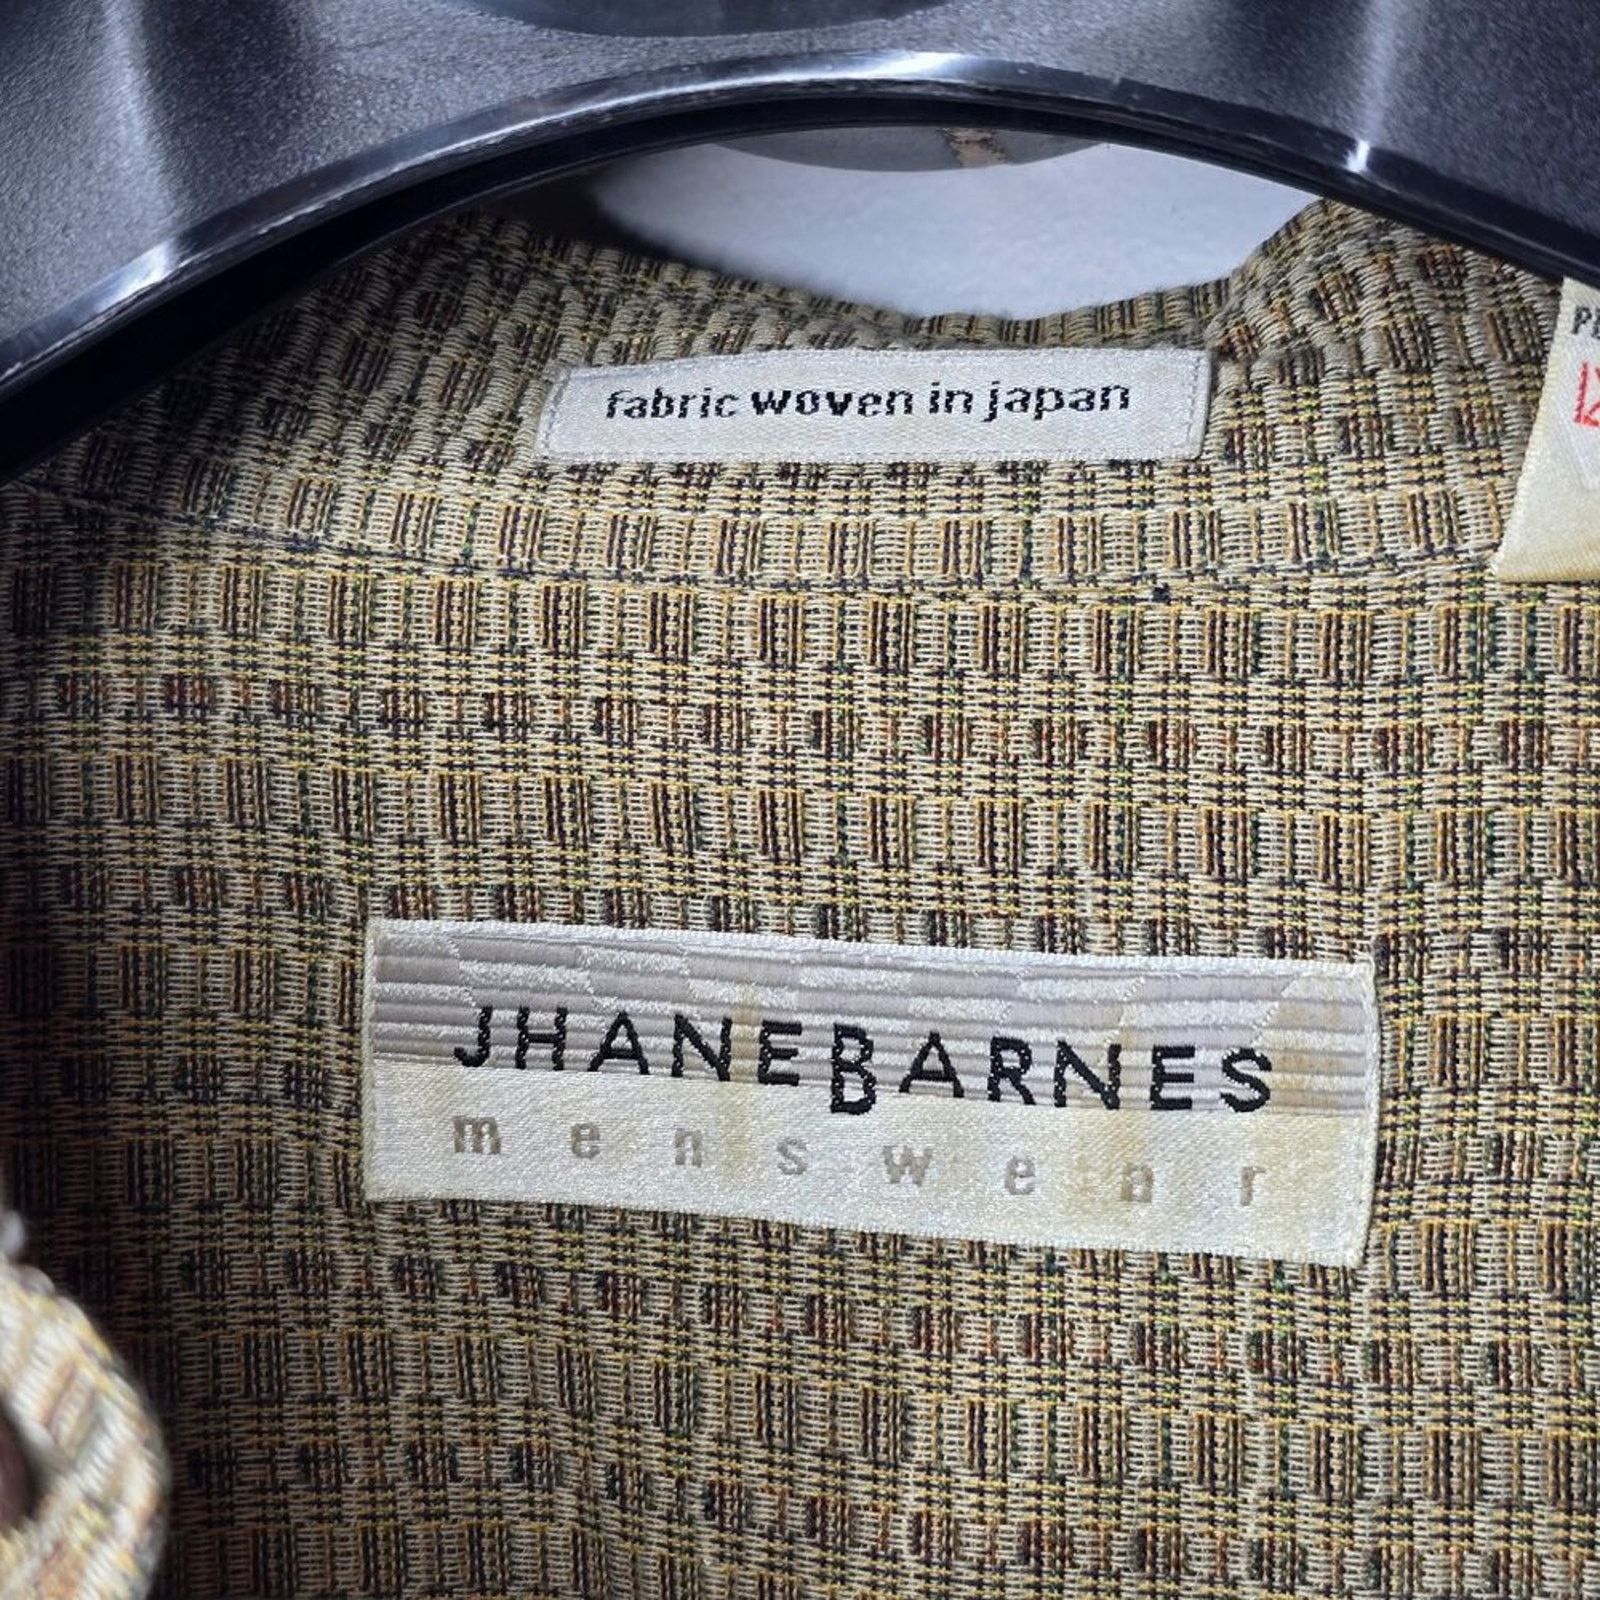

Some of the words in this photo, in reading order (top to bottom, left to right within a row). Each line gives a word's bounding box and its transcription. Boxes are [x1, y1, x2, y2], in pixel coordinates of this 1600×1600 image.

[605, 388, 739, 420] fabric
[750, 390, 915, 418] woven
[928, 381, 974, 414] in
[982, 380, 1132, 423] japan
